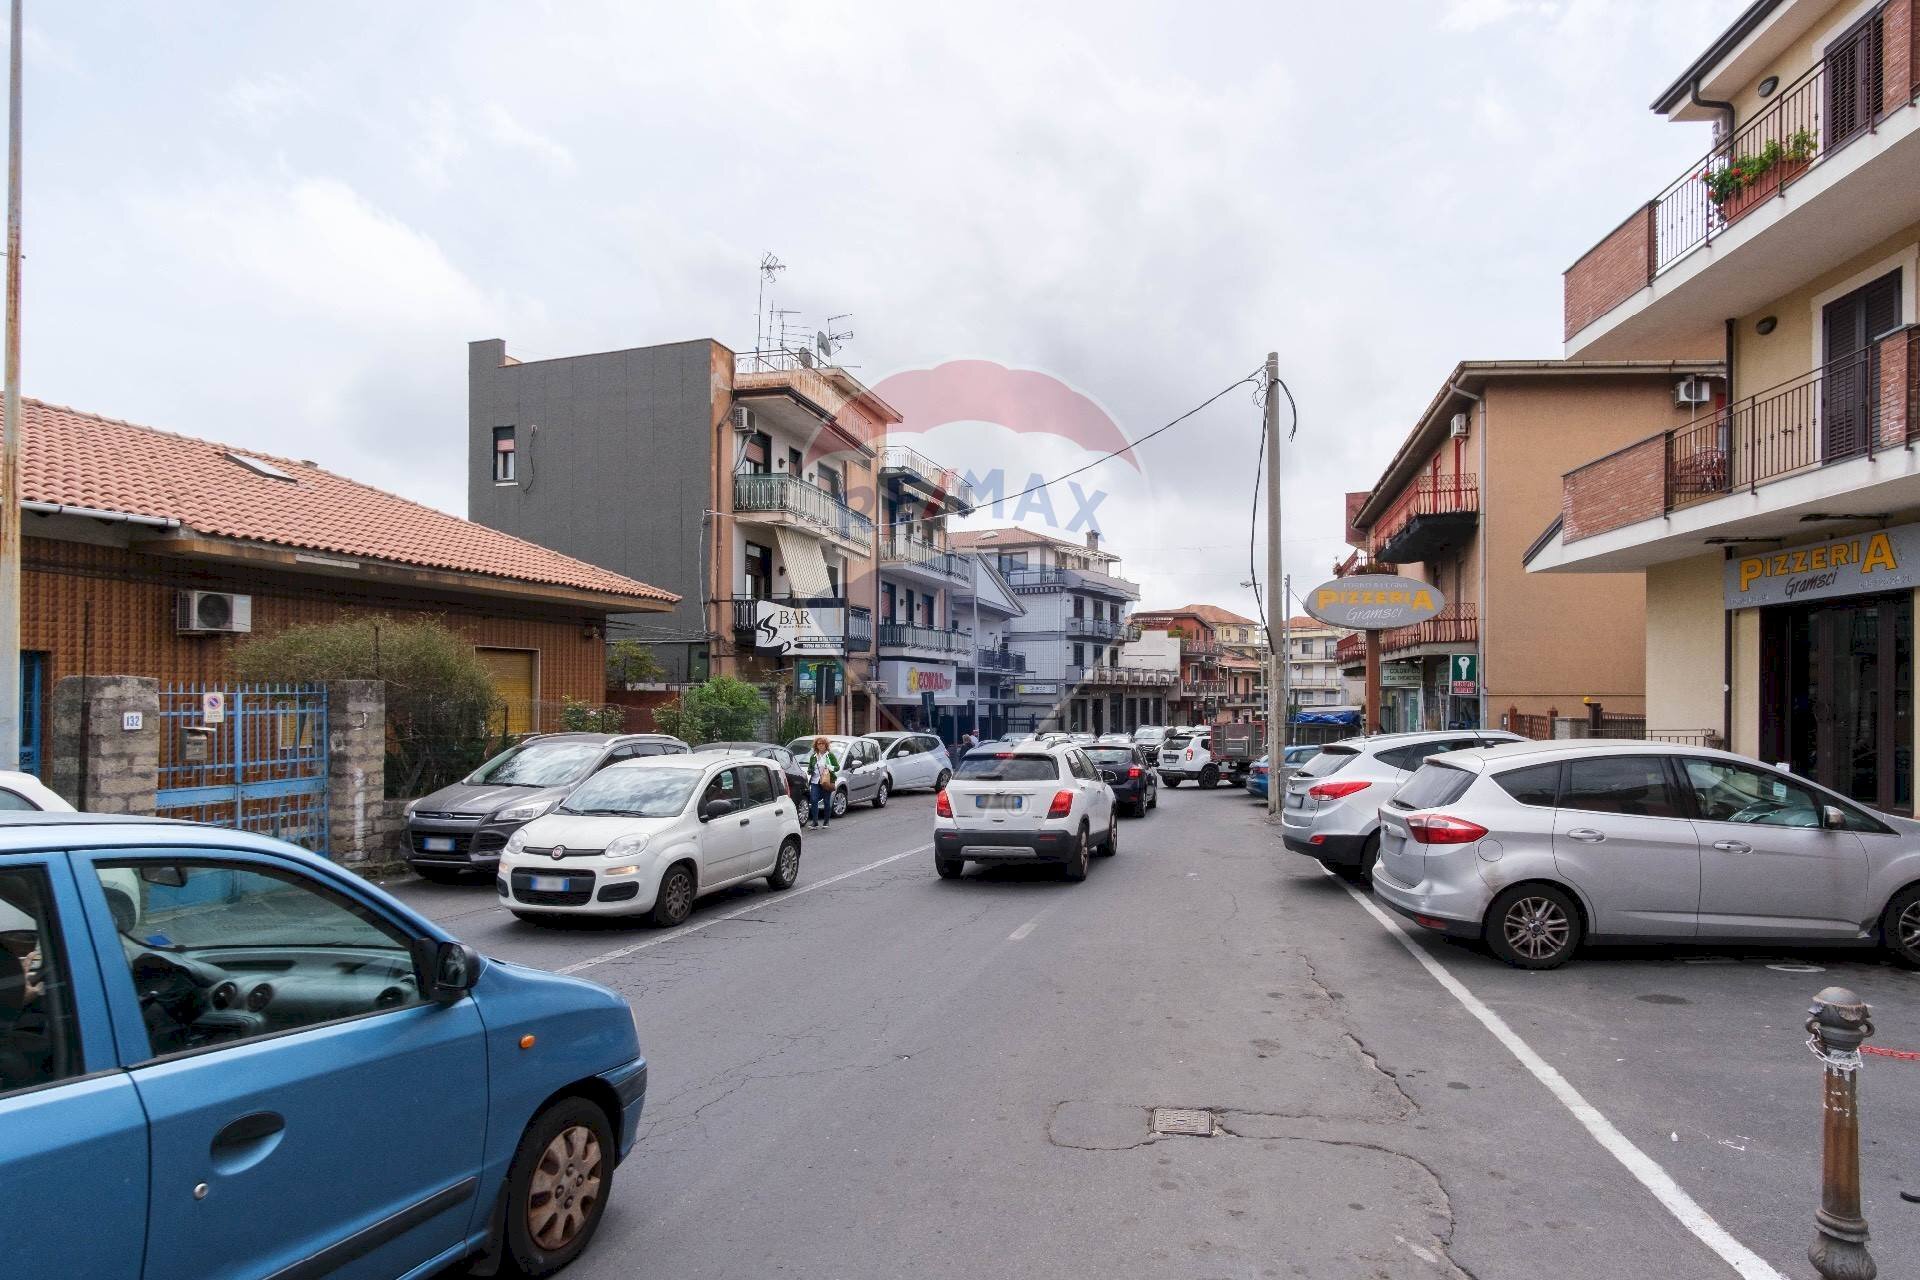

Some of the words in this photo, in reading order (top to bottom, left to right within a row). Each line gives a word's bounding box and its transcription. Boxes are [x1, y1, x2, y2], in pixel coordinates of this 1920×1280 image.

[1740, 532, 1899, 592] PIZZERIA
[1785, 566, 1839, 598] Gramsci
[1317, 588, 1435, 610] PIZZERIA
[779, 610, 811, 625] BAR
[1346, 607, 1403, 623] Gramsci
[126, 715, 139, 727] 132
